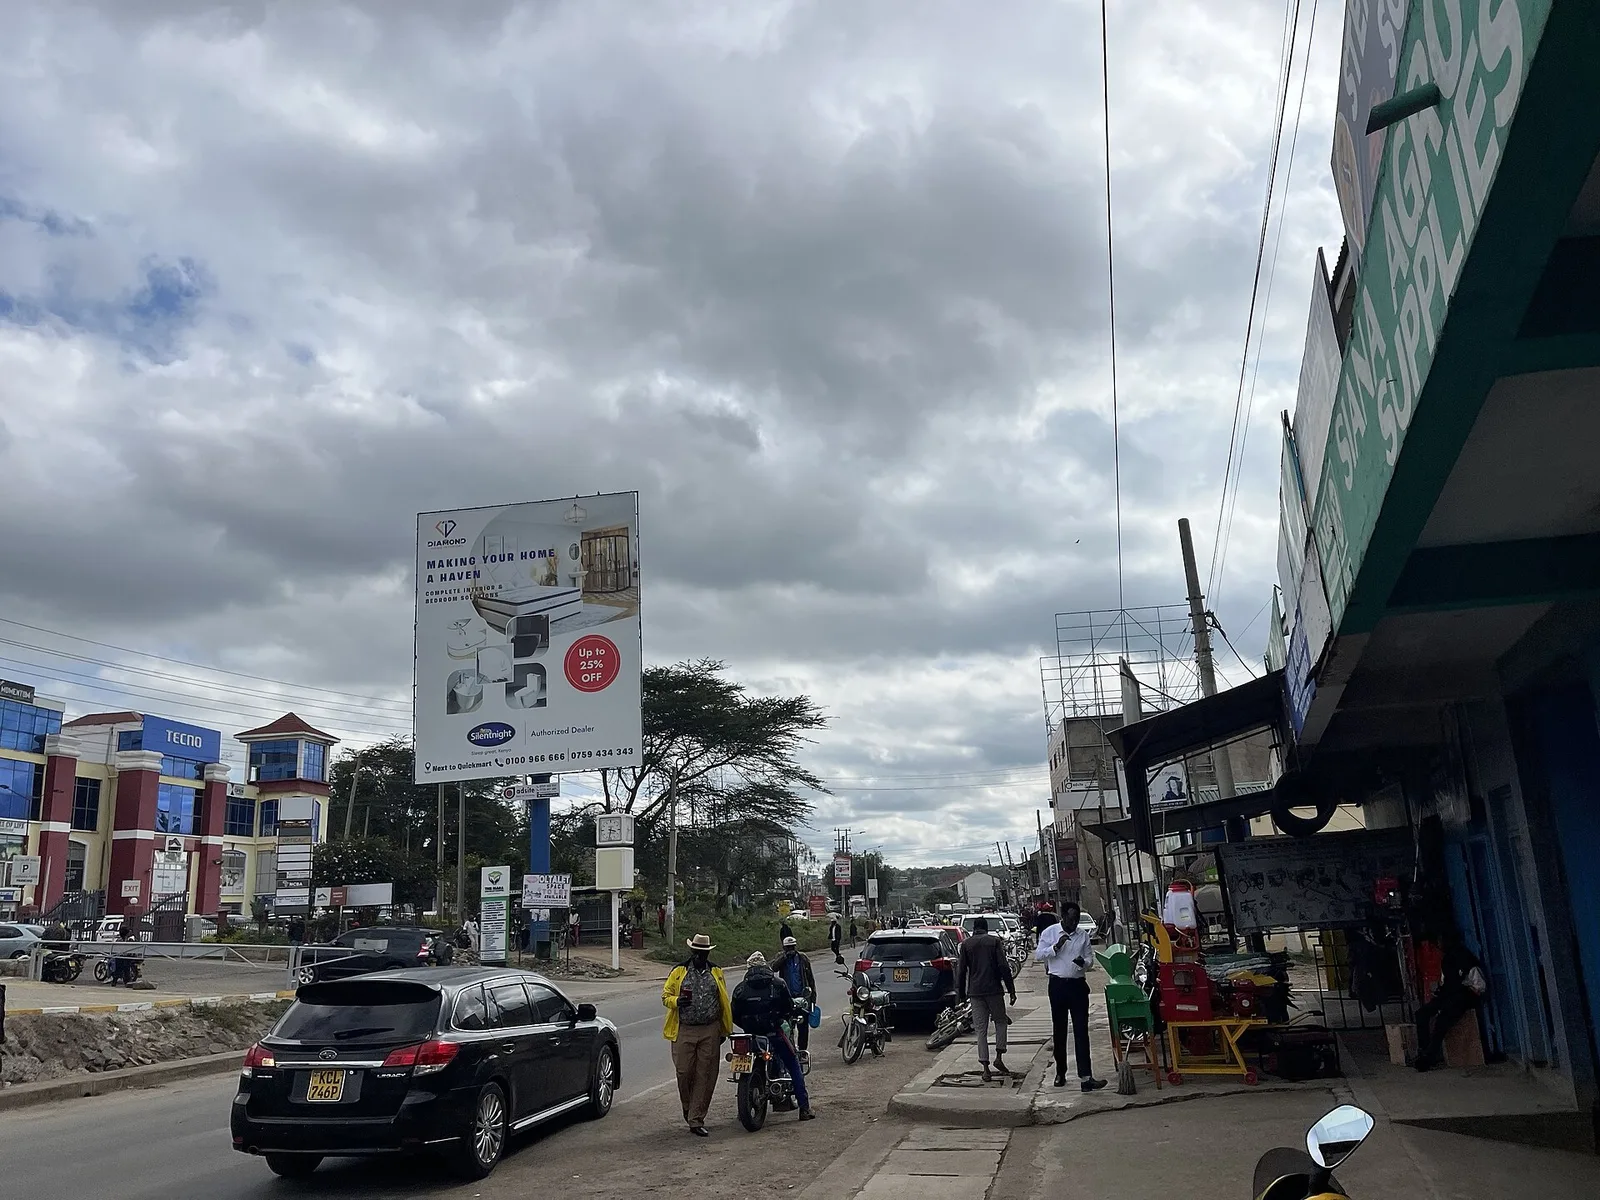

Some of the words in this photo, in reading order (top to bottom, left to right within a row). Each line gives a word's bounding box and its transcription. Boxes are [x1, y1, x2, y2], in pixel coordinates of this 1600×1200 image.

[1378, 0, 1523, 466] SUPPLIES
[1335, 285, 1386, 491] SIANA
[428, 538, 466, 547] DIAMOND
[426, 556, 476, 570] MAKING
[482, 552, 514, 564] YOUR
[521, 548, 555, 560] HOME
[426, 575, 434, 584] A
[440, 570, 481, 582] HAVEN
[425, 596, 458, 604] BEDROOM
[460, 592, 499, 601] SOLUTIONS
[426, 588, 461, 597] COMPLETE
[464, 585, 496, 594] INTERIOR
[579, 648, 592, 659] Up
[595, 648, 606, 656] to
[580, 659, 604, 670] 25%
[581, 673, 602, 683] OFF
[470, 728, 513, 742] Silentnight
[531, 727, 570, 737] Authorized
[572, 725, 595, 734] Dealer
[166, 729, 202, 748] TECNO
[458, 760, 492, 770] Quickmart
[505, 756, 526, 765] 0100
[529, 754, 545, 763] 966
[549, 753, 565, 761] 666
[571, 750, 593, 759] 0759
[596, 749, 613, 758] 434
[616, 748, 633, 756] 343
[22, 864, 29, 873] P
[319, 1070, 340, 1084] KCL
[312, 1086, 339, 1100] 746P
